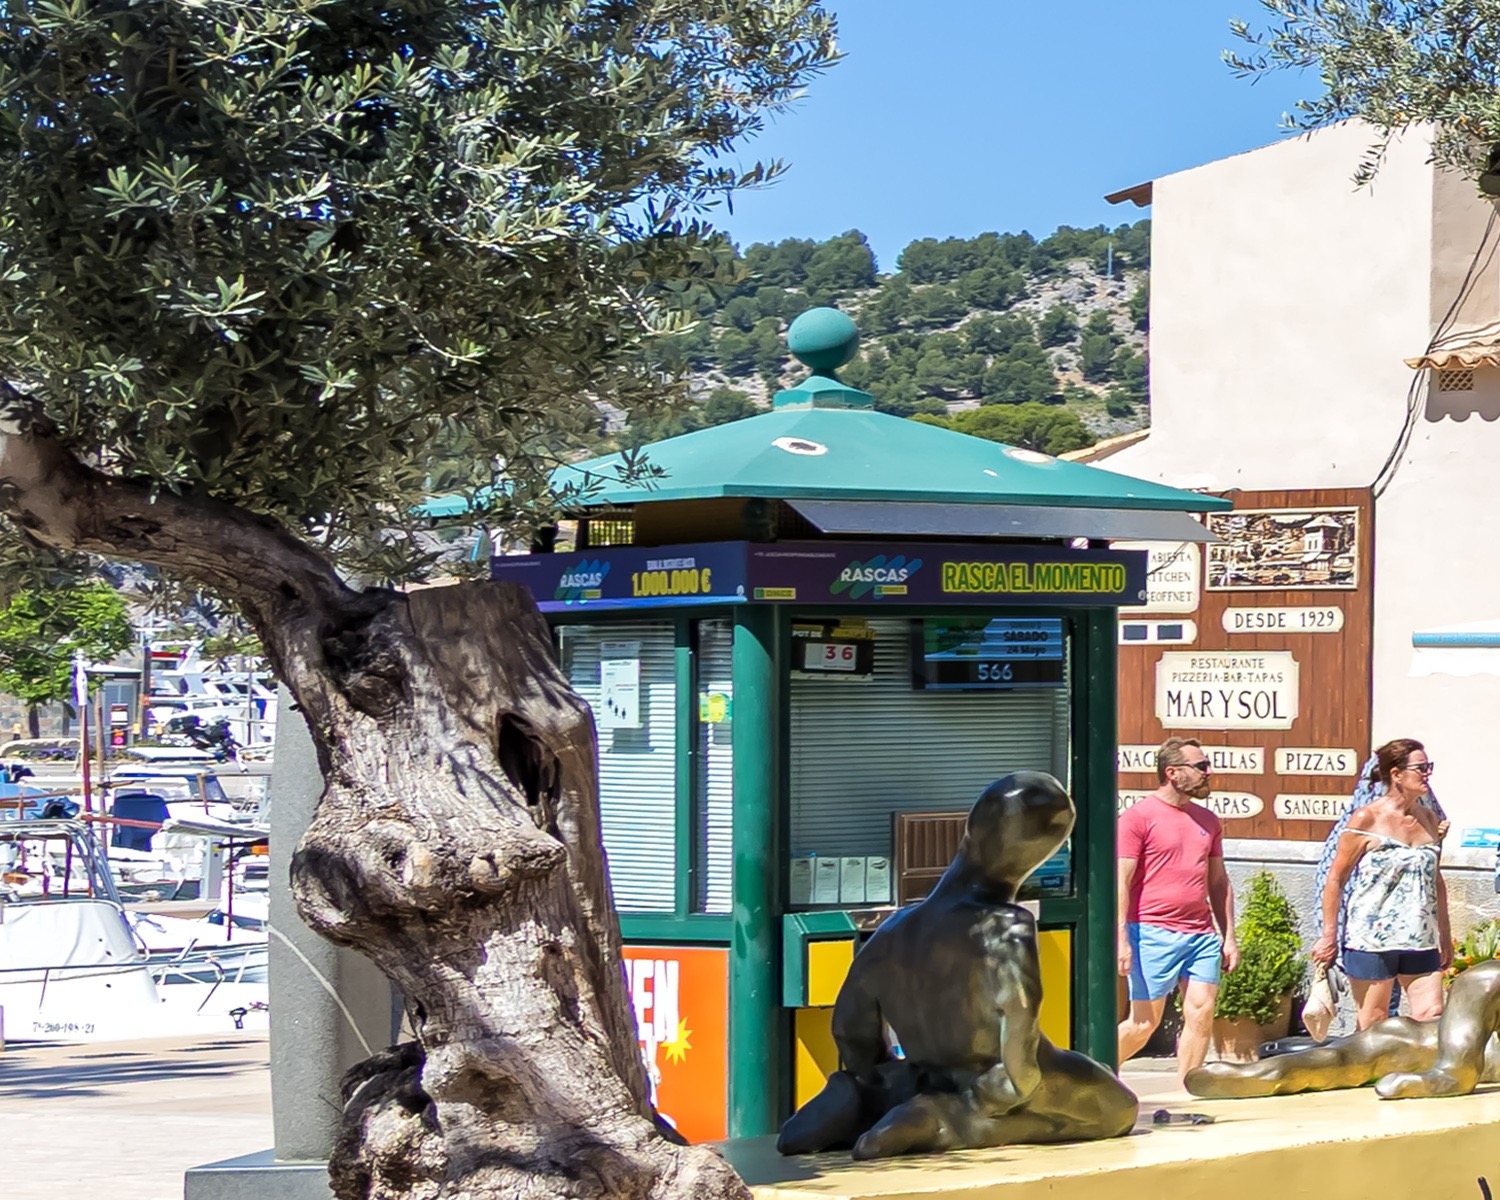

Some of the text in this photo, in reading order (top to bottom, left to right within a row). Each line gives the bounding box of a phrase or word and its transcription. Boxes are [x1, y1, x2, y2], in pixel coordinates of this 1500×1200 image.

[560, 572, 602, 588] RASCAS
[631, 569, 698, 597] 1.000.000
[700, 568, 712, 594] €
[840, 567, 908, 583] RASCAS
[943, 563, 1125, 592] RASCA EL MOMENTO
[1234, 611, 1335, 628] DESDE 1929
[977, 663, 1013, 680] 566
[1191, 658, 1265, 669] RESTAURANTE
[1172, 671, 1284, 683] PIZZERIA-BAR-TAPAS
[1285, 753, 1346, 771] PIZZAS
[1284, 799, 1347, 816] SANGRIA
